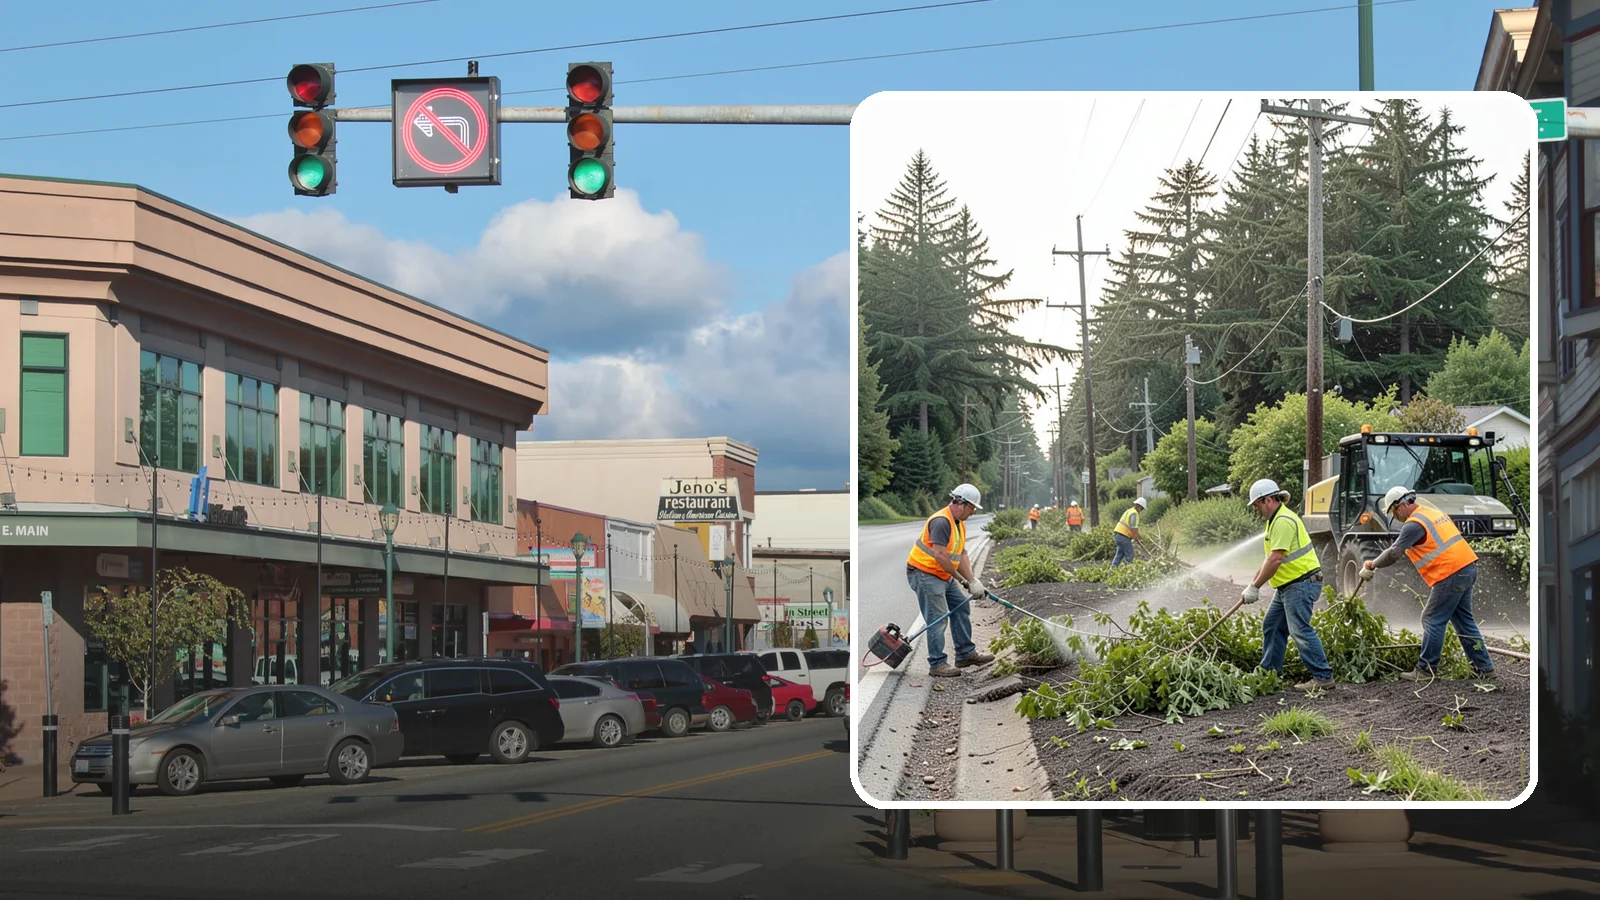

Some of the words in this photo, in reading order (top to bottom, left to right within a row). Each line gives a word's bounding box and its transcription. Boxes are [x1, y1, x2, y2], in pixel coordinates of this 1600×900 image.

[669, 480, 727, 494] Jeno's
[665, 496, 731, 509] restaurant
[658, 509, 682, 519] Italian
[686, 509, 715, 519] American
[714, 509, 738, 519] Cuisine
[2, 525, 13, 536] E.
[15, 525, 49, 536] MAIN
[797, 607, 828, 617] Street
